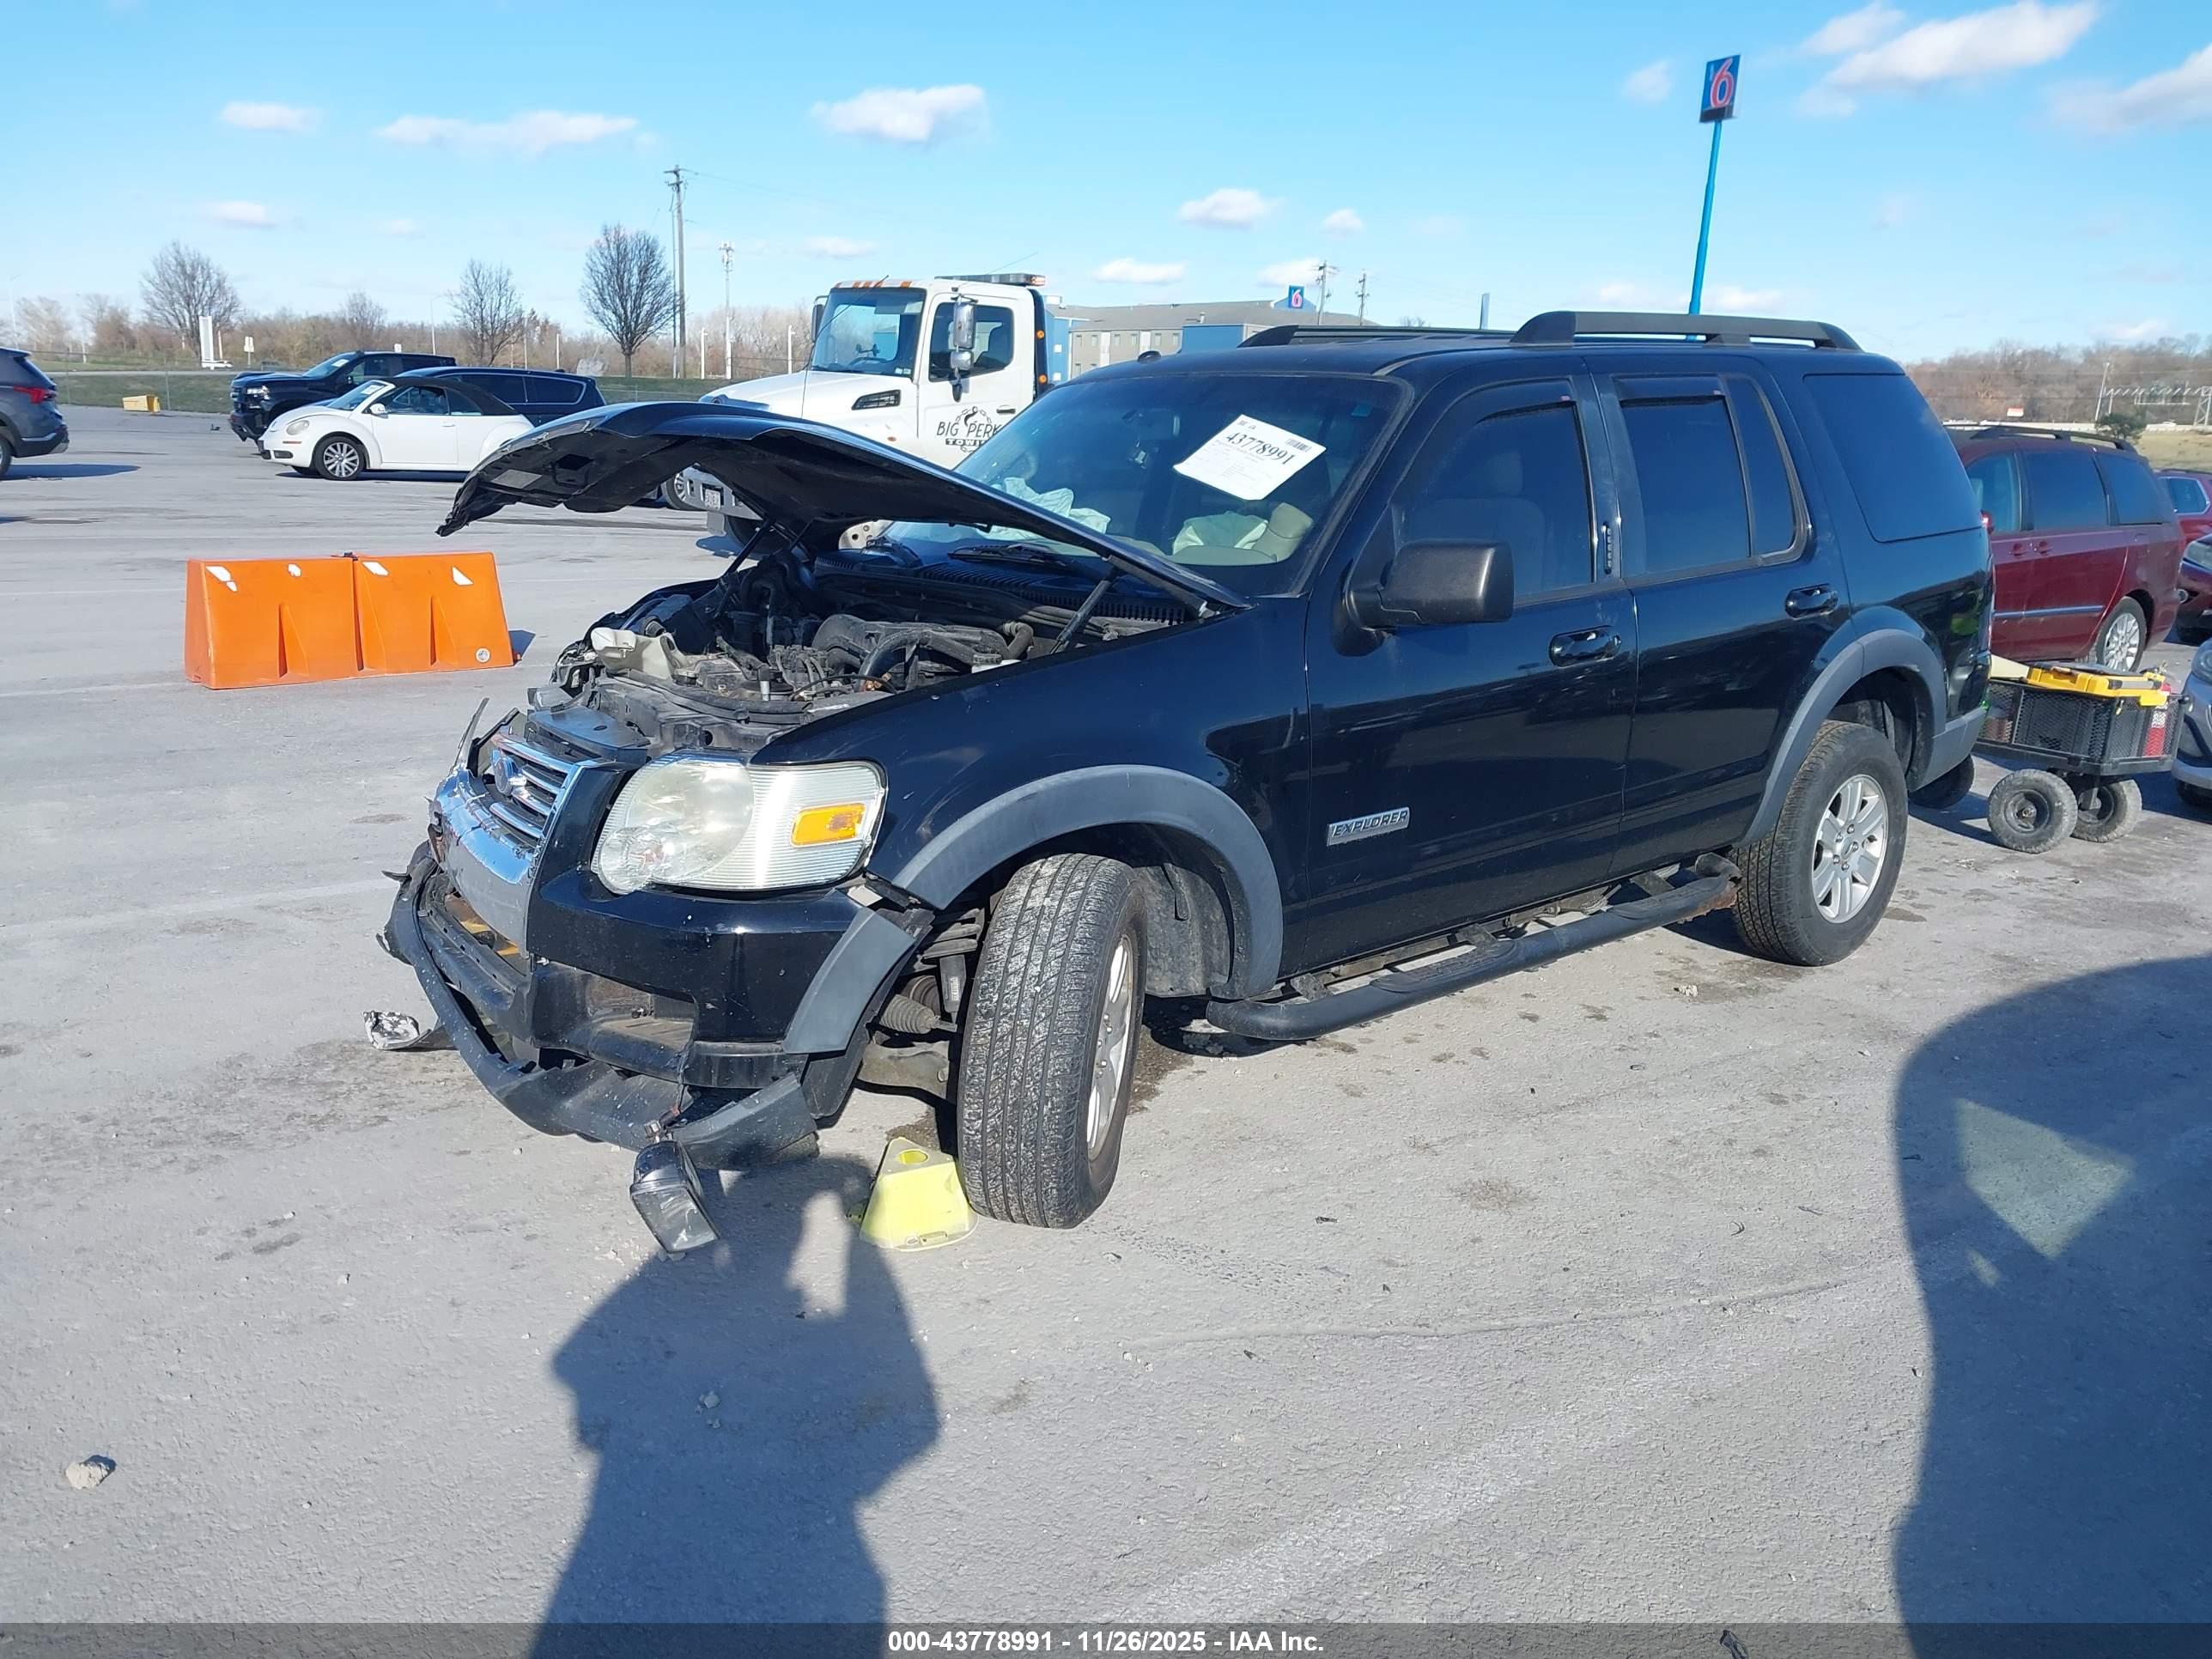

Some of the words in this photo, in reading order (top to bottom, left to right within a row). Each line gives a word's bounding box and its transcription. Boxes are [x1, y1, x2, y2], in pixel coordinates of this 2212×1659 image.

[1711, 58, 1734, 109] 6
[1291, 289, 1303, 308] 6
[937, 421, 960, 436] BIG
[1226, 432, 1295, 465] 43778991
[1332, 810, 1408, 837] EXPLORER
